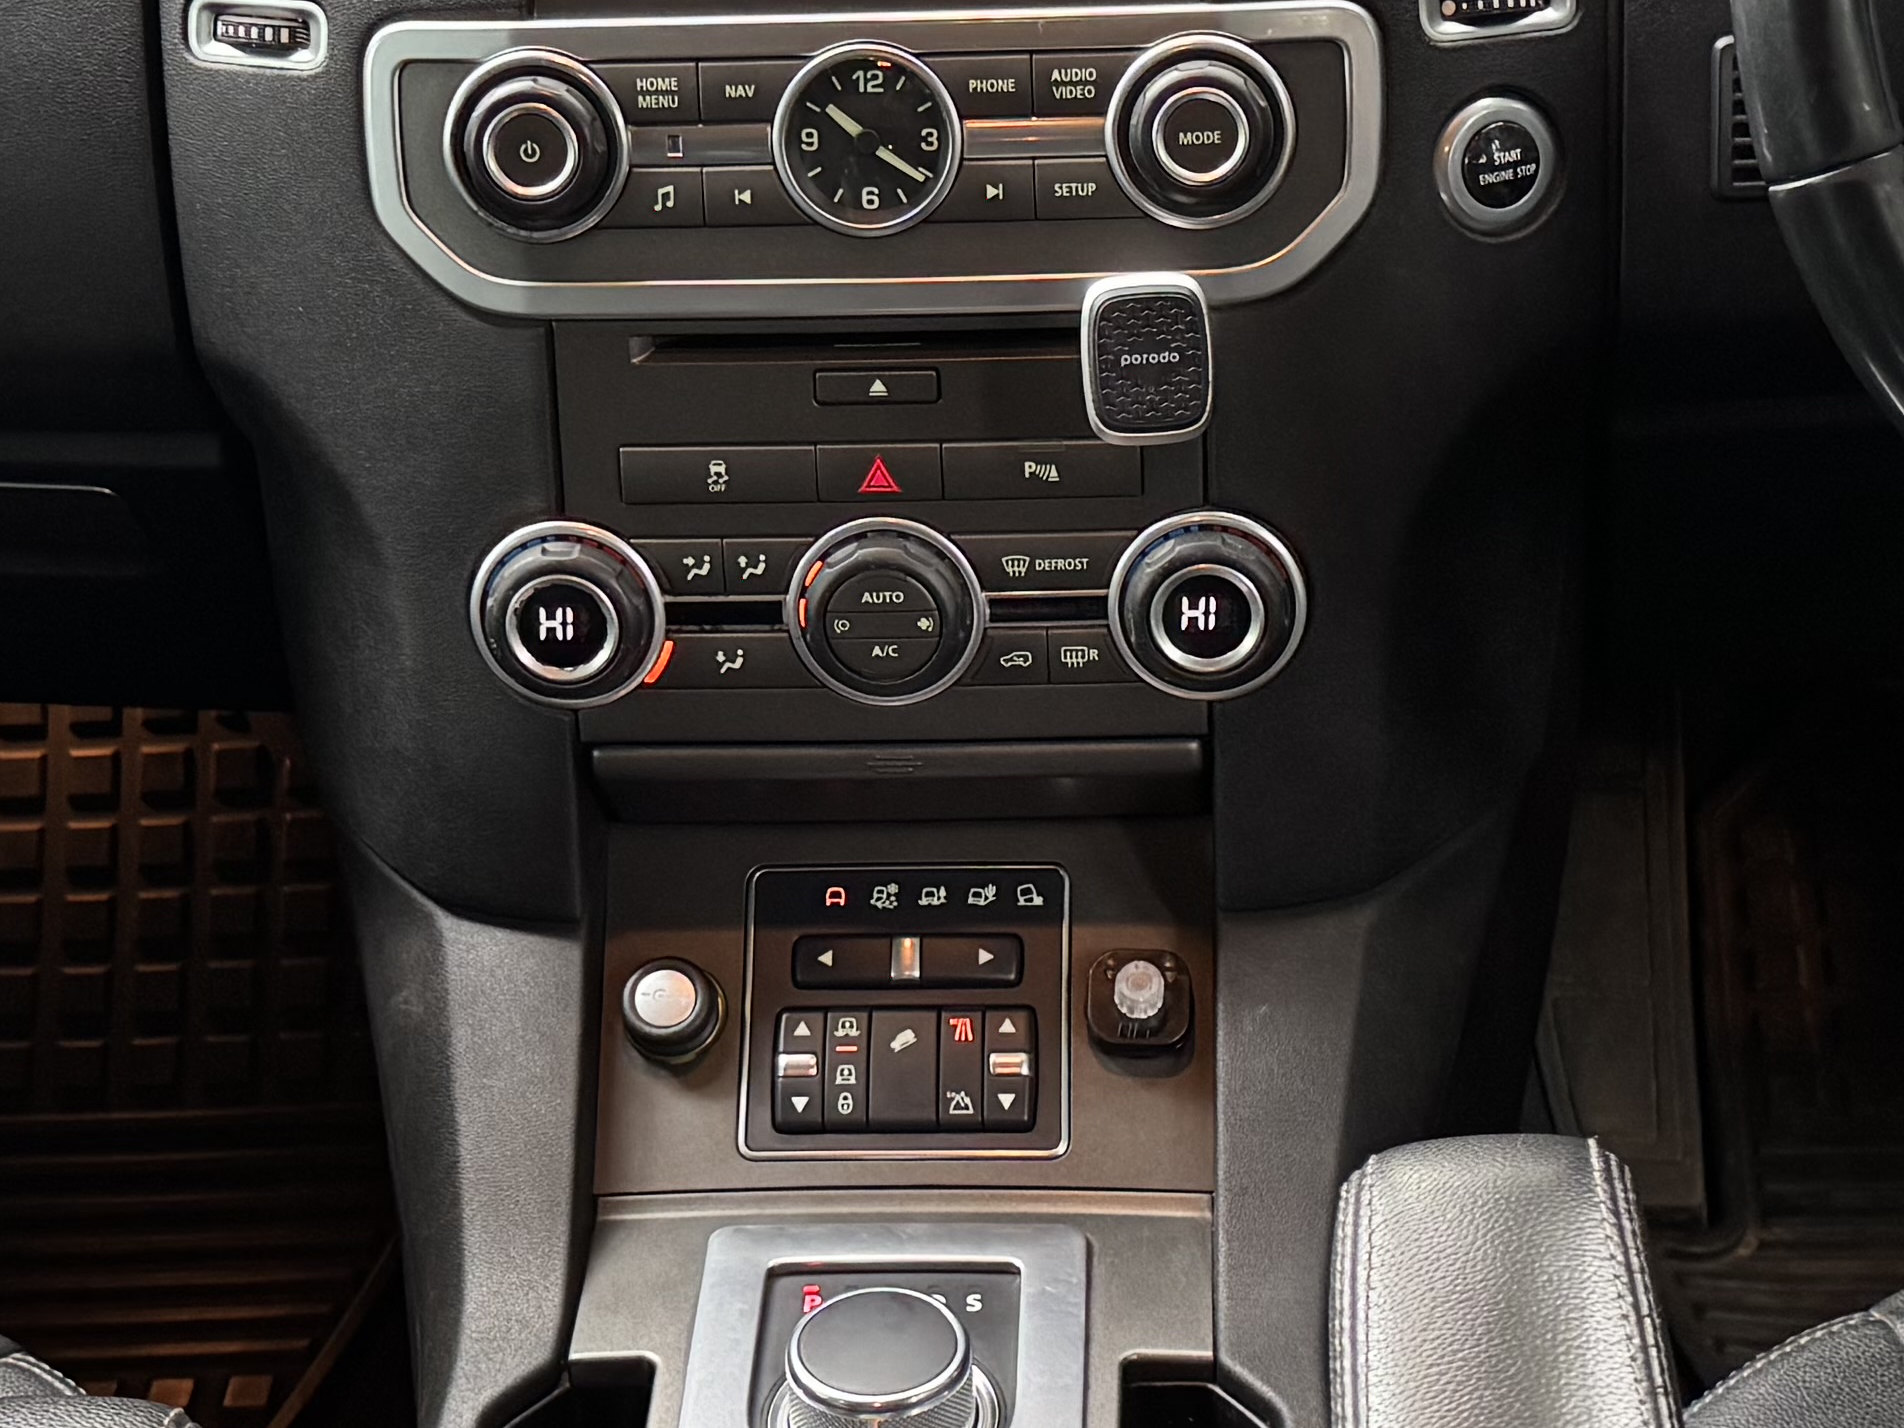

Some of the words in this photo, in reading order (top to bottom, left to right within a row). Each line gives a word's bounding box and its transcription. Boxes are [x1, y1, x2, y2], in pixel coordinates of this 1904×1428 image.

[852, 70, 884, 93] 12
[1050, 68, 1097, 82] AUDIO
[636, 77, 678, 91] HOME
[725, 84, 755, 98] NAV
[968, 78, 1016, 93] PHONE
[1052, 85, 1095, 99] VIDEO
[637, 94, 678, 108] MENU
[800, 128, 819, 151] 9
[920, 129, 938, 152] 3
[1178, 130, 1222, 145] MODE
[1493, 148, 1522, 165] START
[1479, 169, 1514, 185] ENGINE
[1517, 164, 1537, 179] STOP
[1054, 183, 1097, 197] SETUP
[861, 187, 880, 210] 6
[1120, 349, 1180, 367] porodo
[708, 482, 726, 492] OFF
[1035, 557, 1089, 572] DEFROST
[861, 590, 904, 604] AUTO
[1180, 596, 1216, 631] HI
[538, 607, 574, 641] HI
[871, 644, 898, 658] A/C
[803, 1294, 823, 1313] P
[965, 1293, 984, 1313] S
